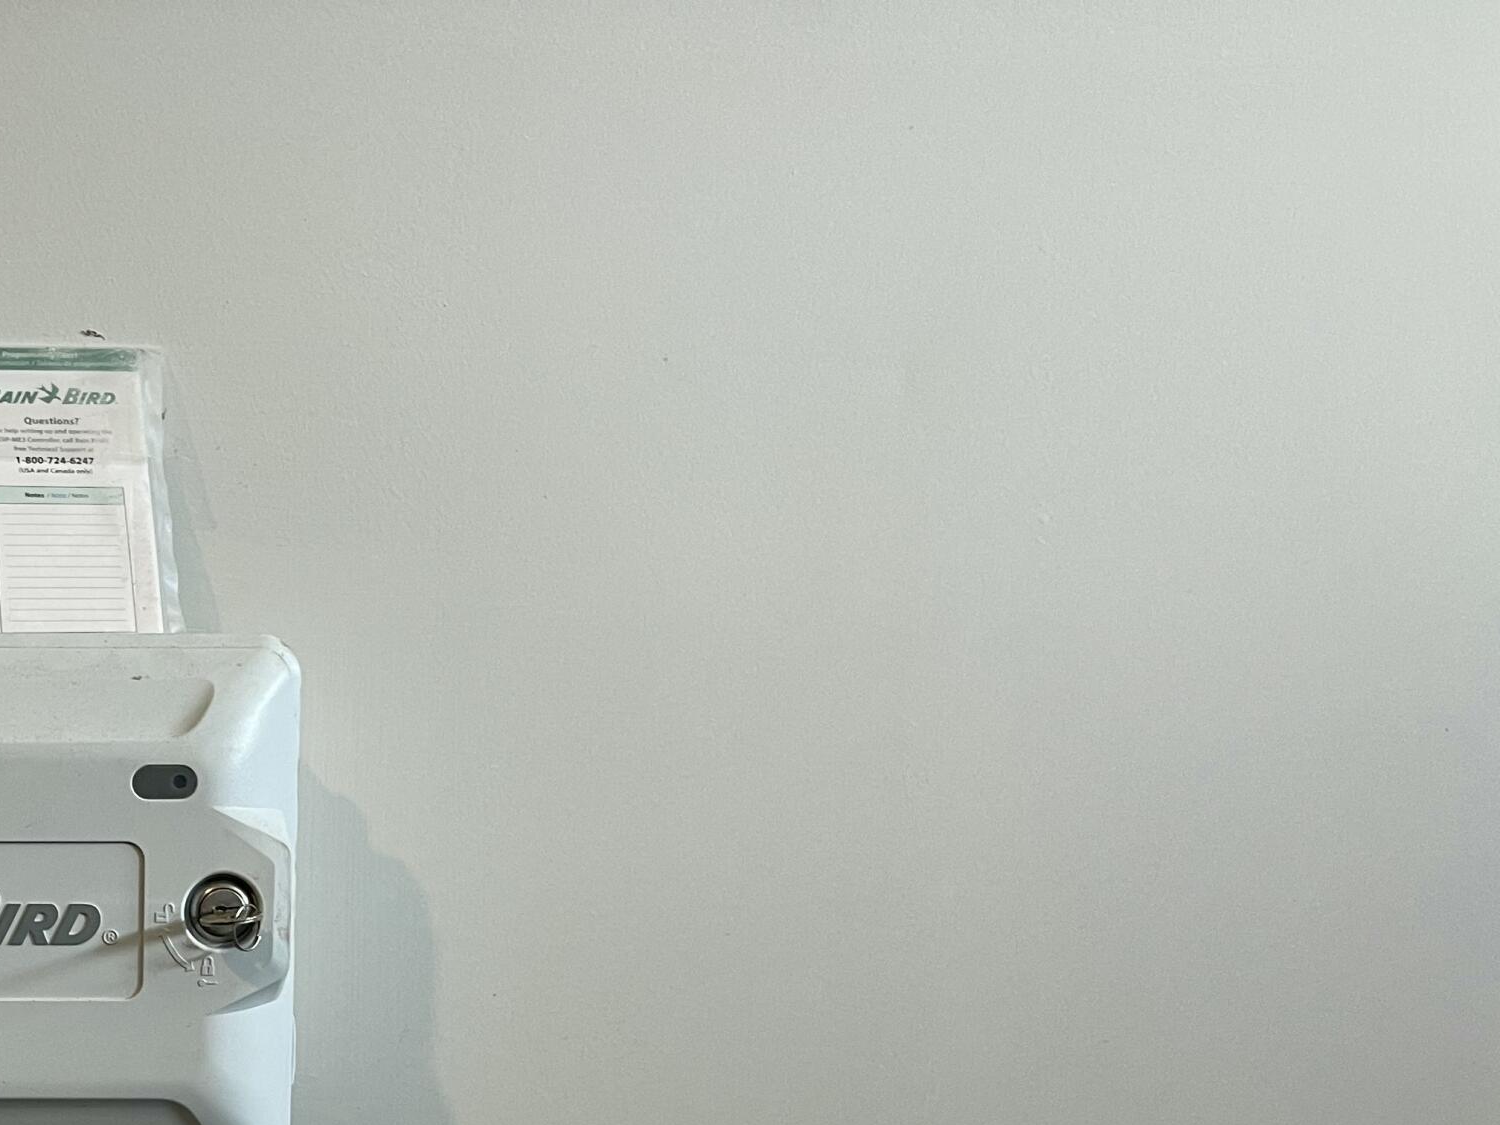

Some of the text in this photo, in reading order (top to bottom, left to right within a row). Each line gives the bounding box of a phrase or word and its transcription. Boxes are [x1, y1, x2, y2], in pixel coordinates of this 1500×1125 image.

[62, 388, 116, 405] BIRD
[24, 417, 80, 425] Questions?
[16, 456, 94, 465] 1-800-724-6247
